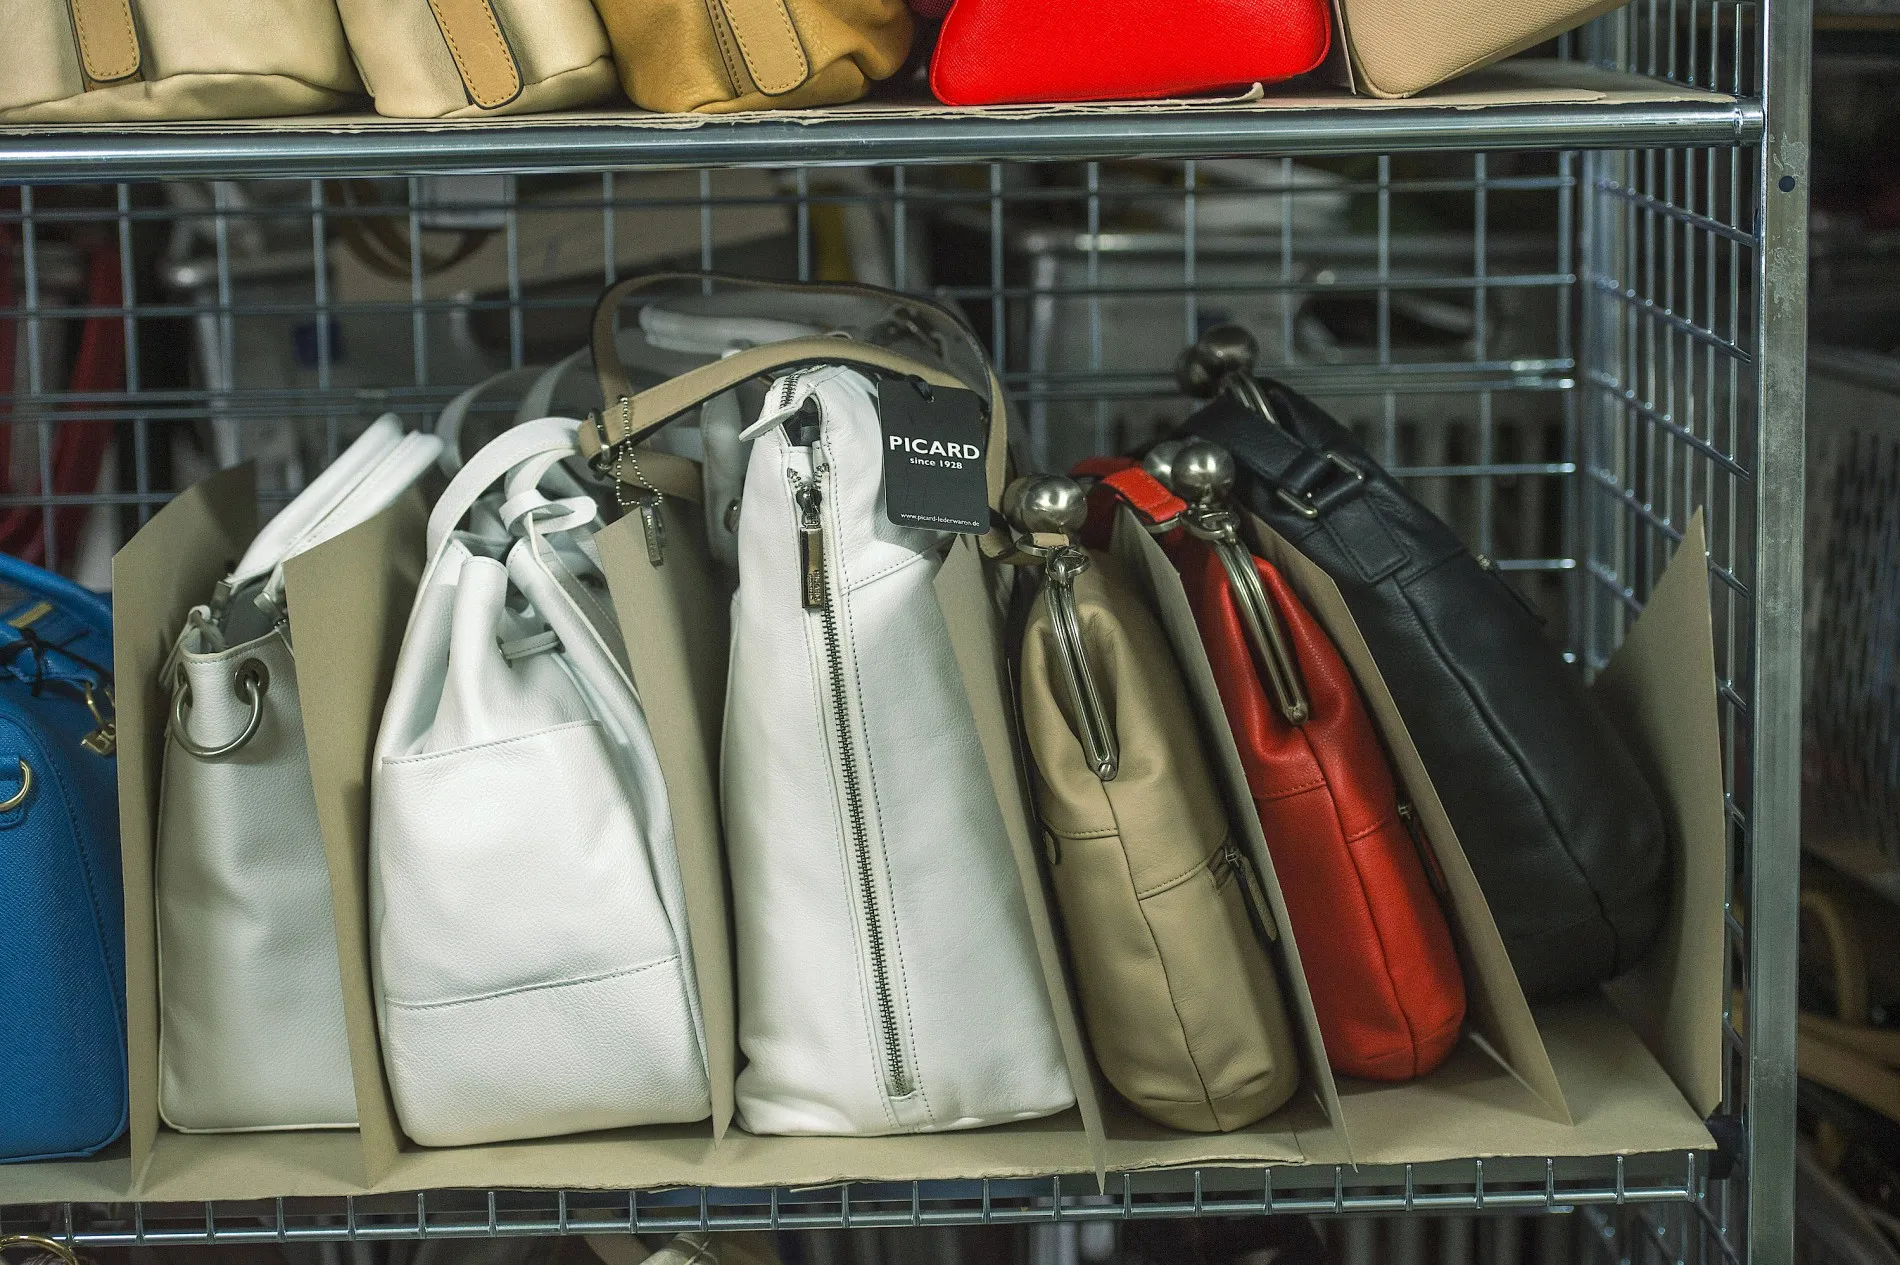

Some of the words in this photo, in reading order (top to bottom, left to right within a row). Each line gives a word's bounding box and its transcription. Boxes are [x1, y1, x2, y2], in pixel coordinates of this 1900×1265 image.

[889, 435, 980, 460] PICARD
[909, 457, 936, 467] since
[939, 459, 963, 470] 1928
[900, 513, 980, 527] www.picard-lederwaren.de
